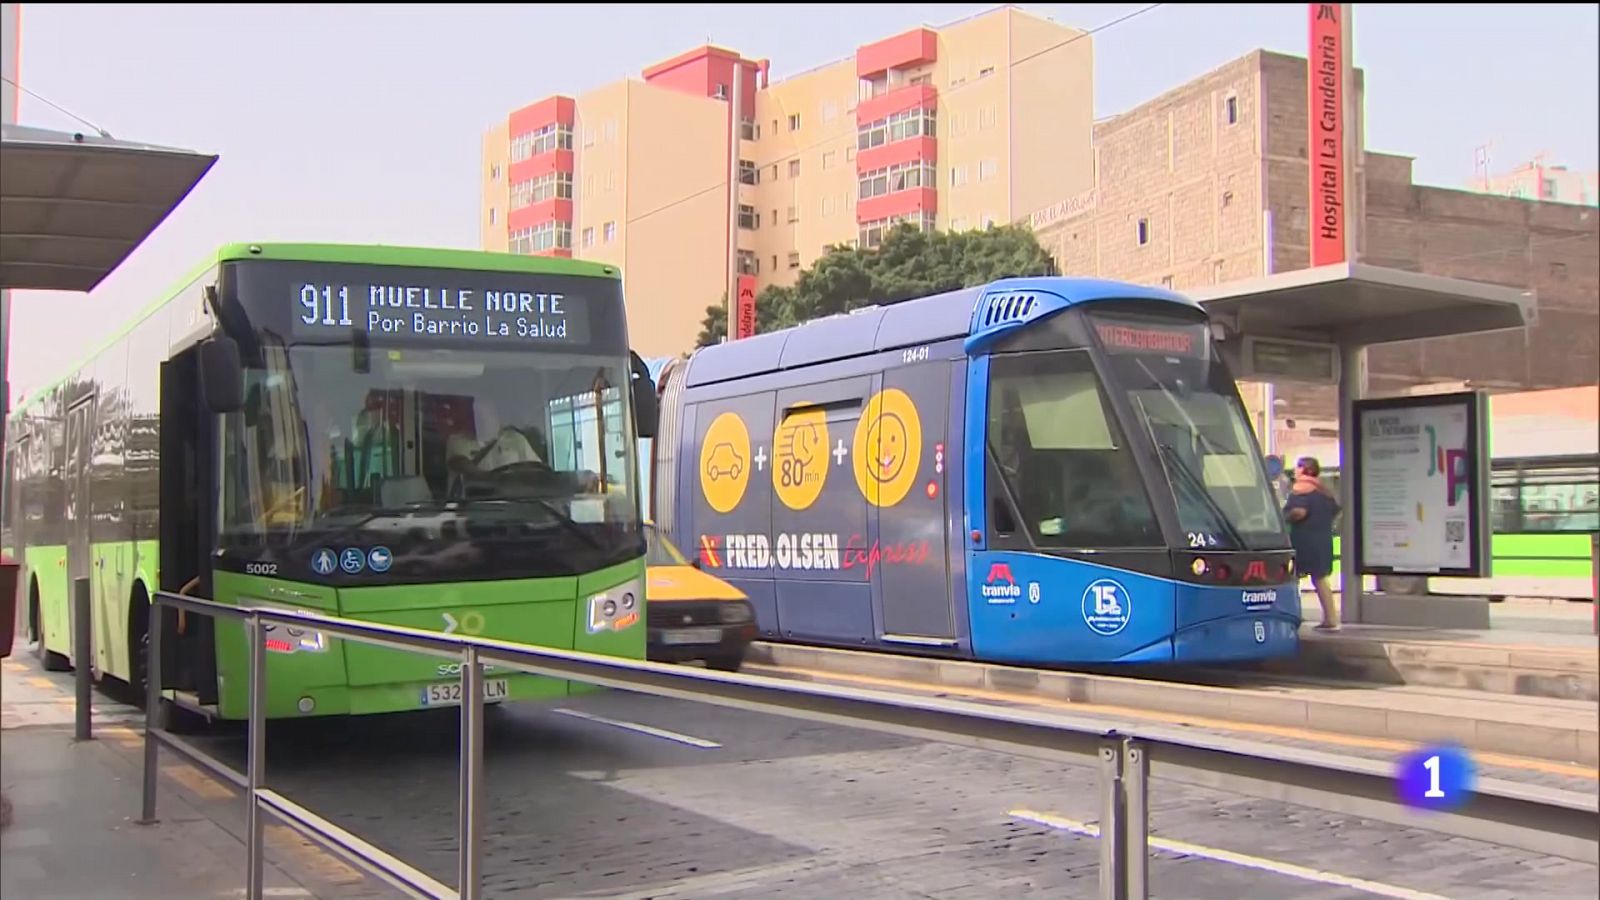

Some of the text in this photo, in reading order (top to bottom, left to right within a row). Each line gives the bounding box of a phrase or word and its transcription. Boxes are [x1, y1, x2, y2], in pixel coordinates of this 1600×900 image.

[1319, 35, 1341, 240] Hospital La Candelaria
[301, 284, 352, 326] 911
[370, 285, 564, 314] MUELLE NORTE
[368, 311, 567, 338] Por Barrio La Salud
[903, 346, 929, 363] 124-01
[781, 459, 804, 487] 80
[1188, 532, 1206, 547] 24
[246, 564, 277, 575] 5002
[777, 533, 839, 569] OLSEN
[843, 534, 929, 580] Express
[1092, 586, 1118, 613] 15
